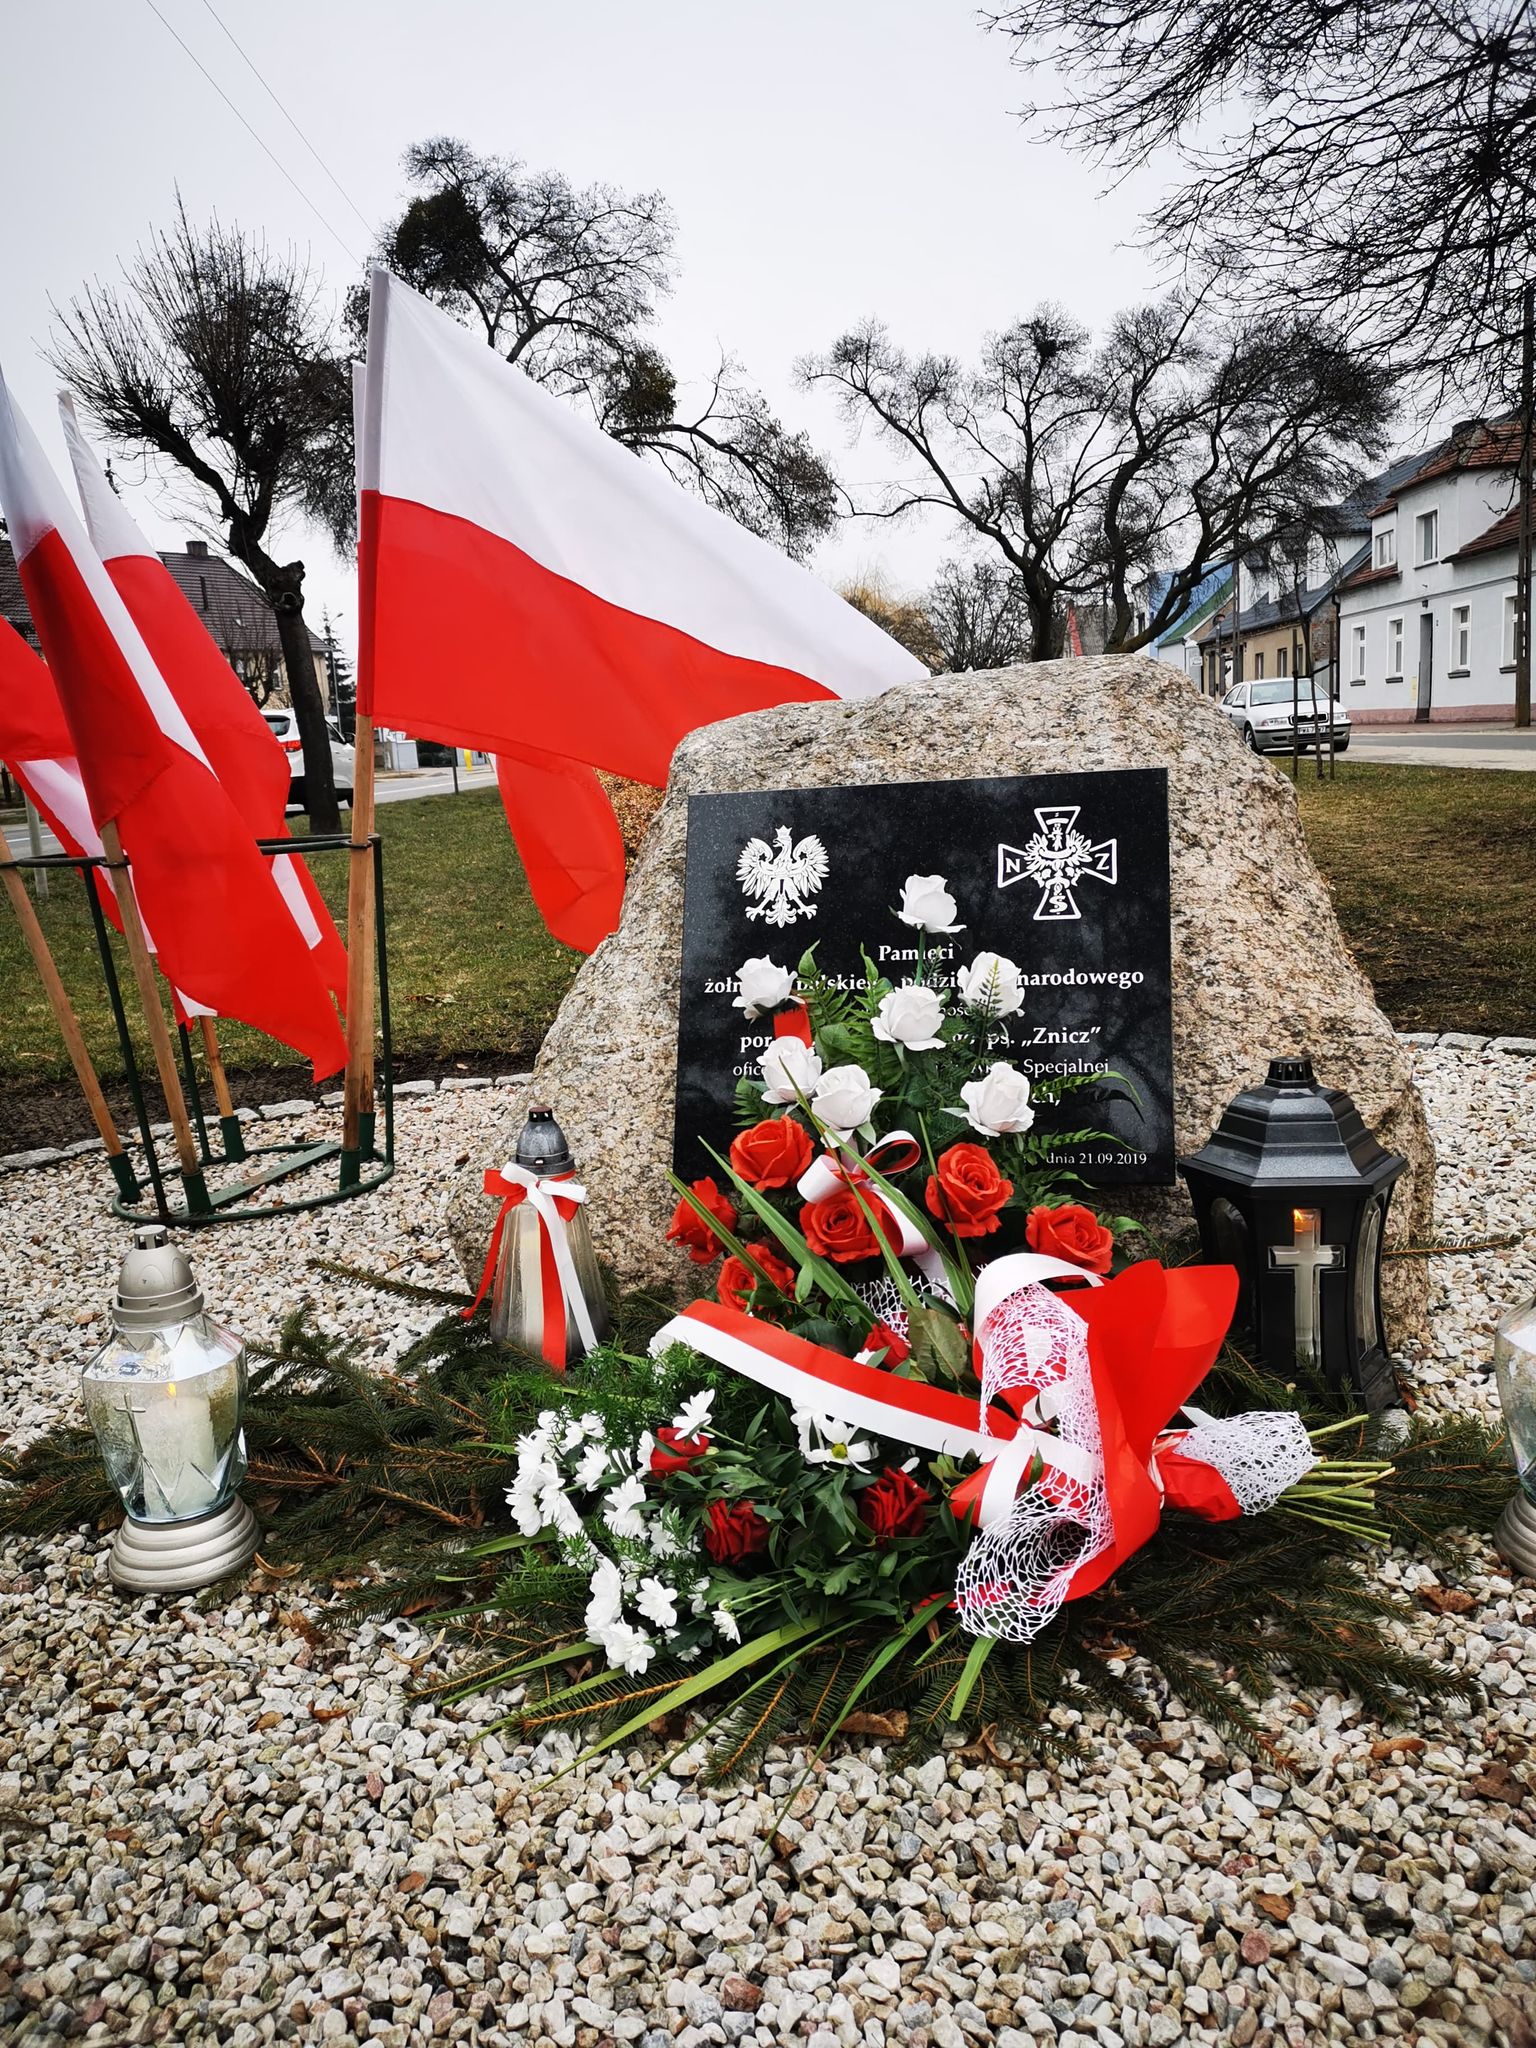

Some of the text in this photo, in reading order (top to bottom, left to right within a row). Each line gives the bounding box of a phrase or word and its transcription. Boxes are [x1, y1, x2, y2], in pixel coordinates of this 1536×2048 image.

[1005, 857, 1020, 873] N
[1094, 852, 1110, 870] Z
[1017, 967, 1144, 989] narodowego
[1023, 1058, 1109, 1078] Specjalnej
[1046, 1152, 1147, 1165] dnia 21.09.2019
